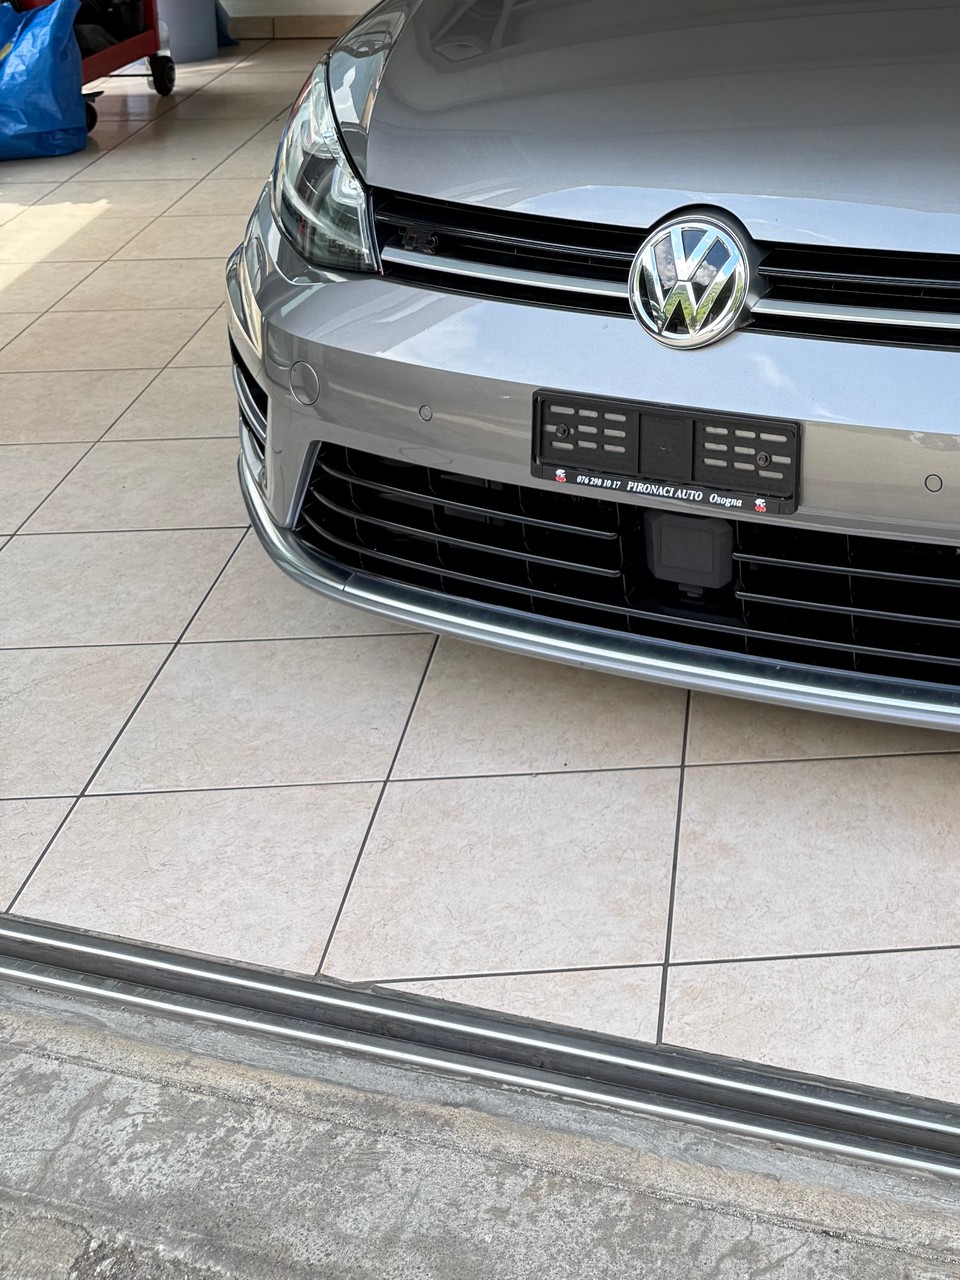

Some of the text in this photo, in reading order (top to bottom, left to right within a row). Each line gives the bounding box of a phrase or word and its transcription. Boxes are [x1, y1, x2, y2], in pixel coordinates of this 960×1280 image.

[576, 475, 743, 508] 076 298 10 17 PIRONACI AUTO Osogna
